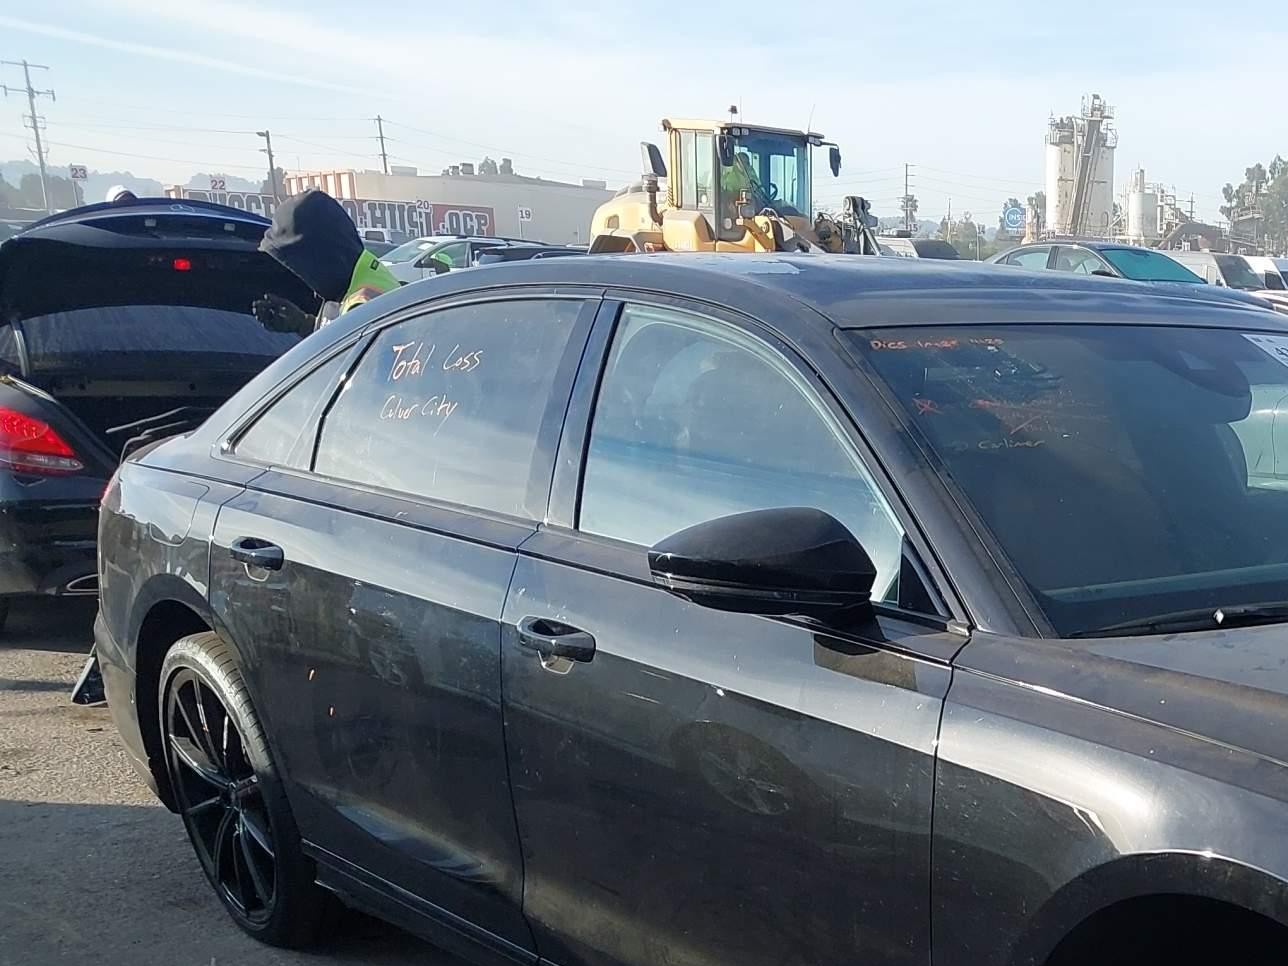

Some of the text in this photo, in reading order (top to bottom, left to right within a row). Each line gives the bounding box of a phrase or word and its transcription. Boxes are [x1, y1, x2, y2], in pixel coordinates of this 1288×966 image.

[71, 167, 87, 179] 23
[210, 180, 225, 190] 22
[417, 200, 429, 209] 20
[520, 210, 531, 219] 19
[387, 341, 483, 381] Total Loss
[421, 394, 457, 437] City
